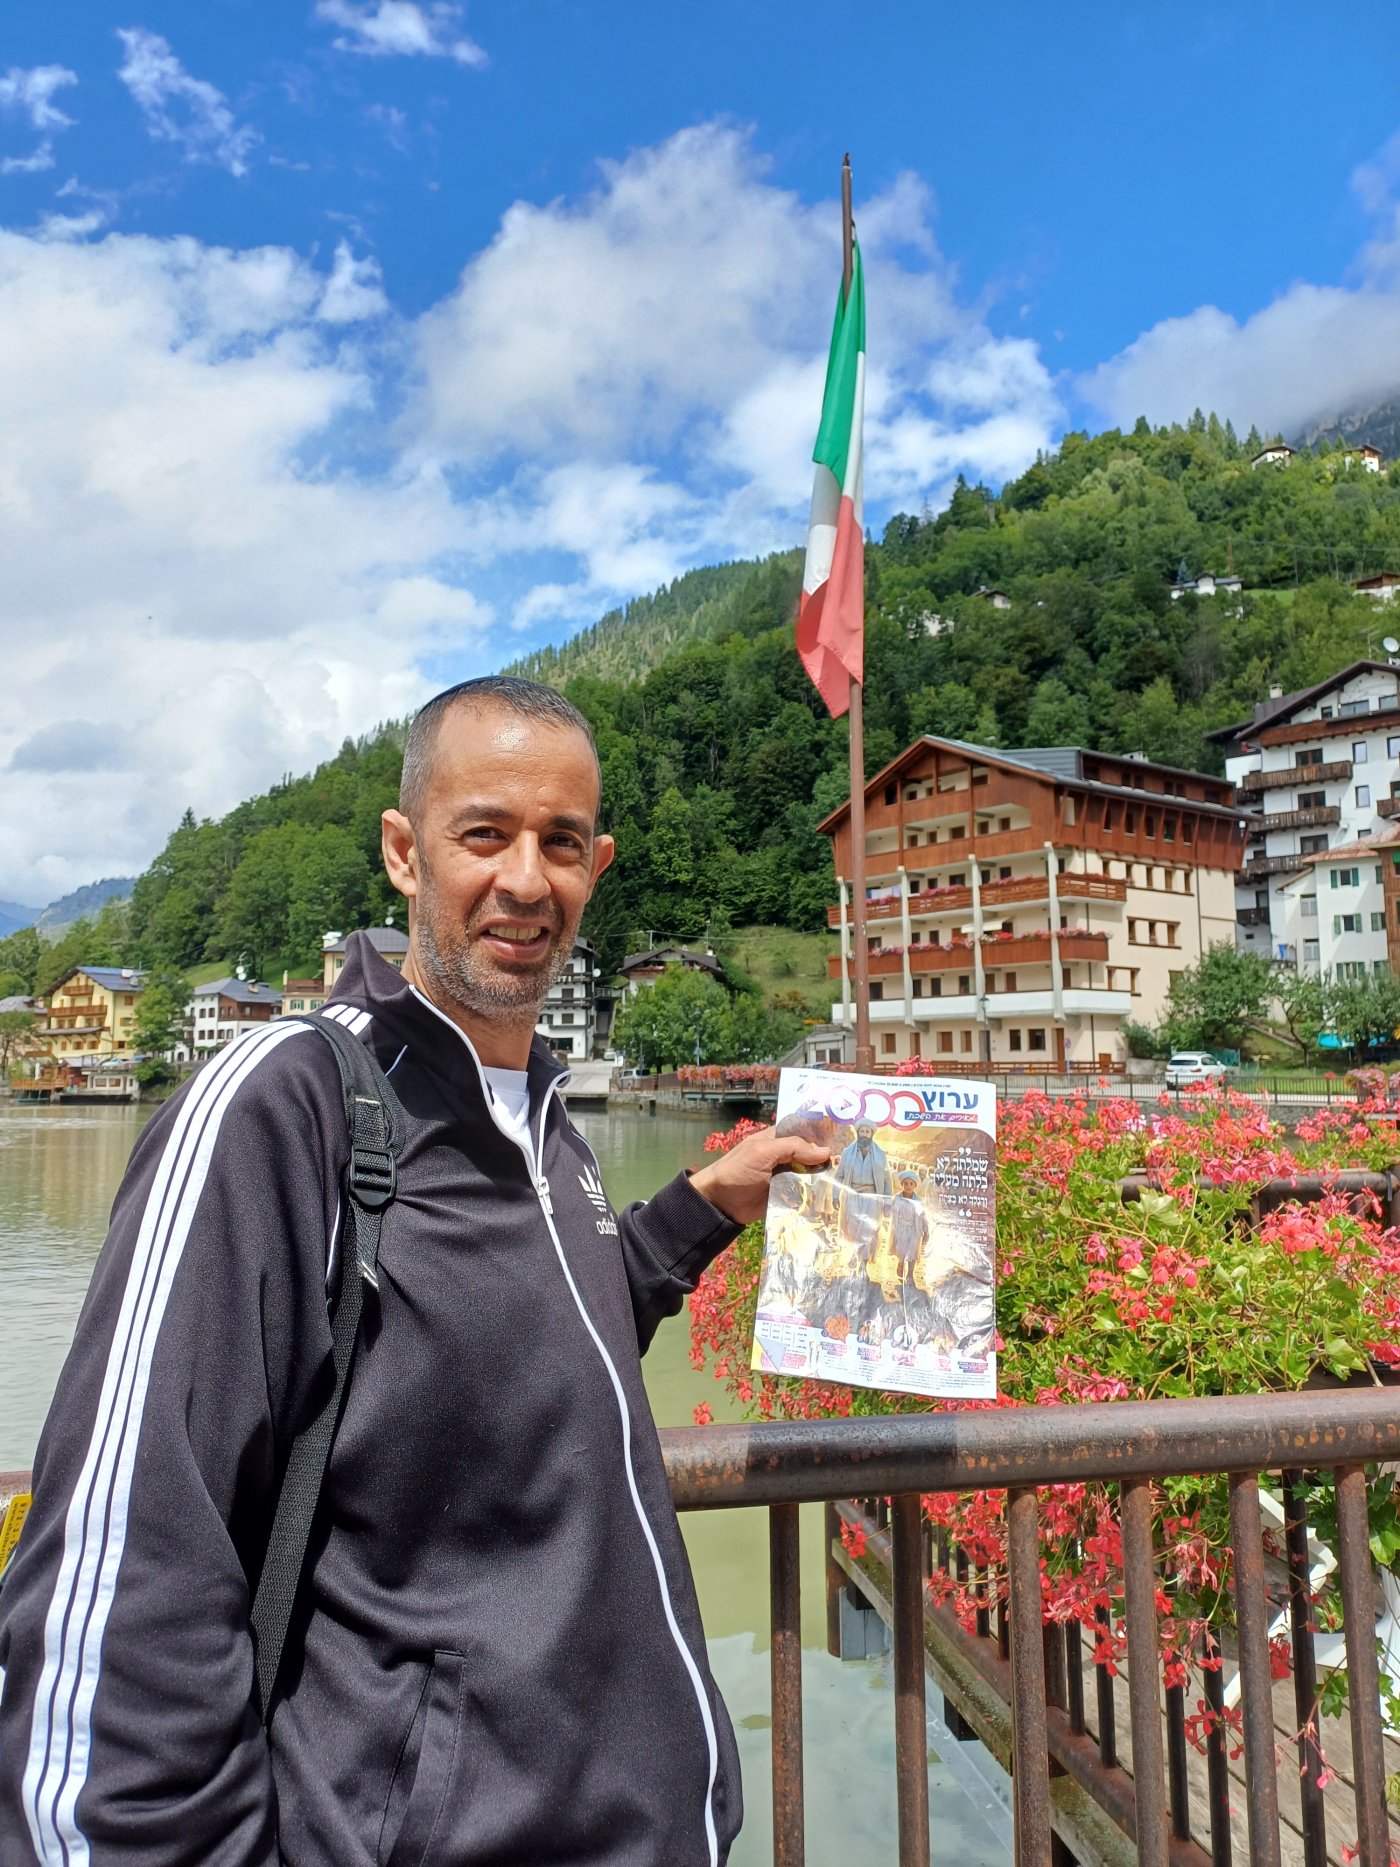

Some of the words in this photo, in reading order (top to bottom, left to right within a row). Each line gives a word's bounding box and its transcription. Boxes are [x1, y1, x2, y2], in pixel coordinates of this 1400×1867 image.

[921, 1090, 979, 1111] ערוץ
[907, 1112, 932, 1120] השבת
[596, 1213, 618, 1237] adidas
